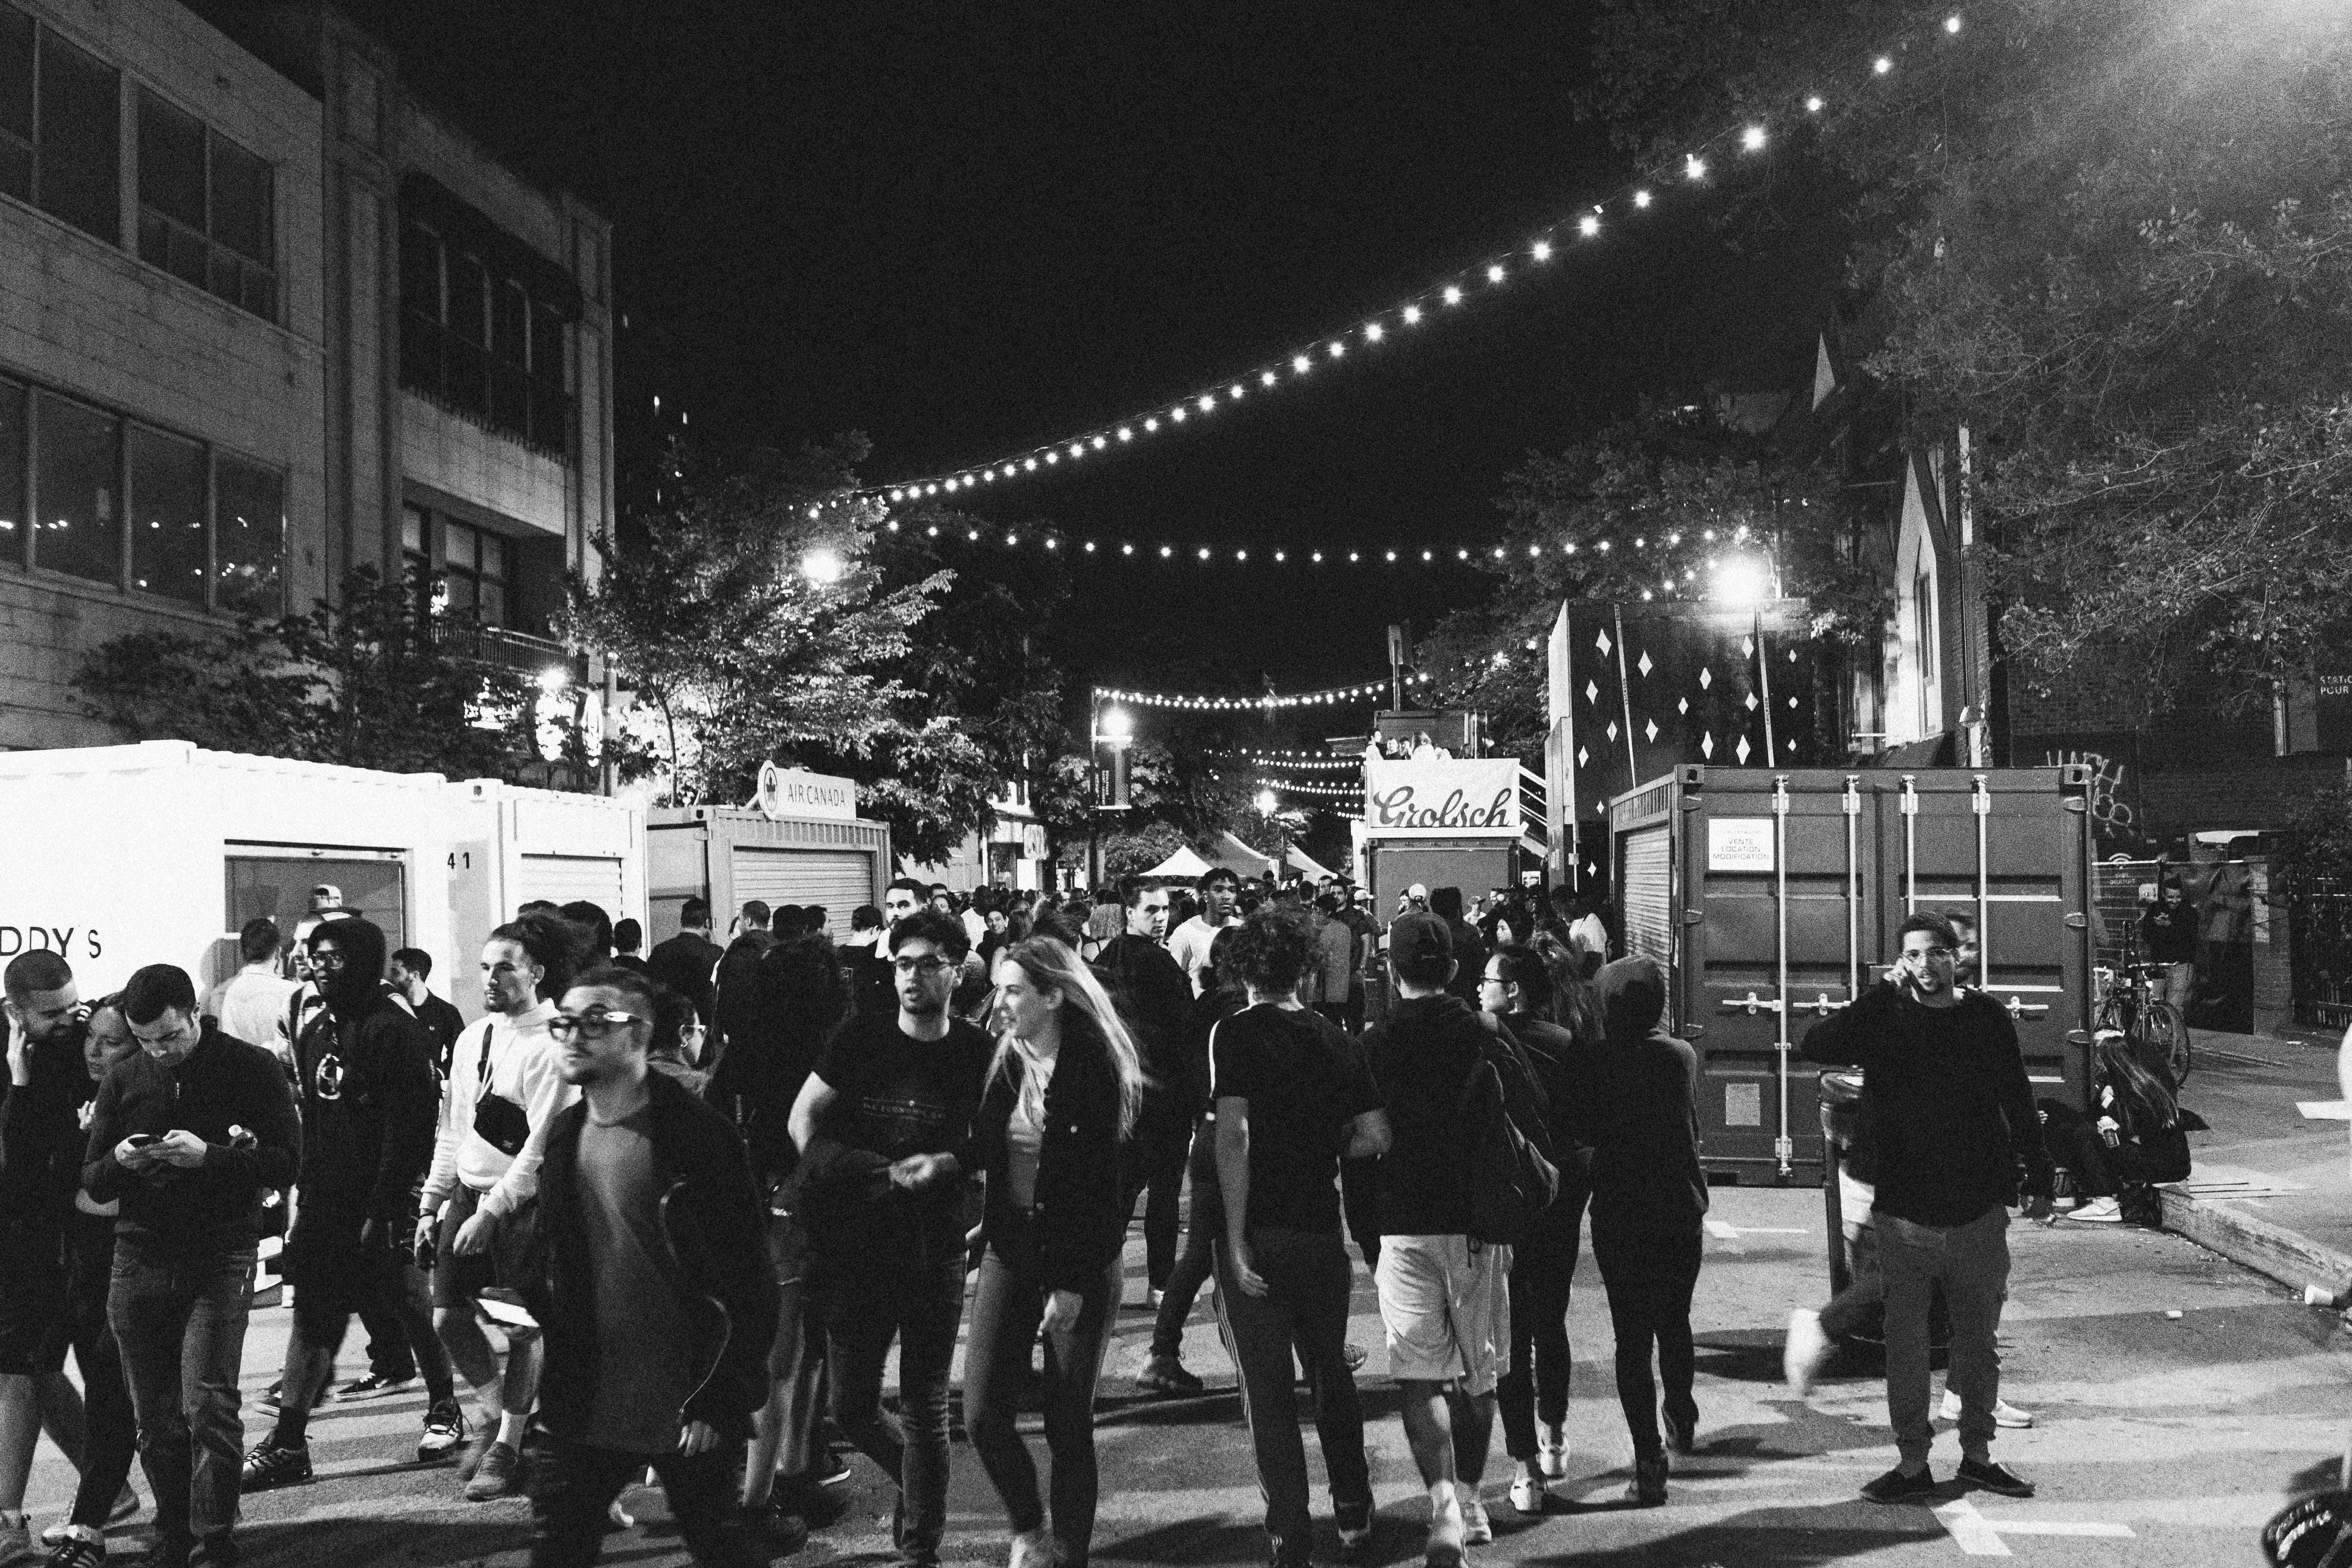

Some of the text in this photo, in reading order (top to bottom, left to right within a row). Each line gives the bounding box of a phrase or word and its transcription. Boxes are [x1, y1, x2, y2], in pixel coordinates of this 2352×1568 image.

[788, 783, 846, 807] AIR CANADA
[1373, 786, 1512, 828] Grolsch
